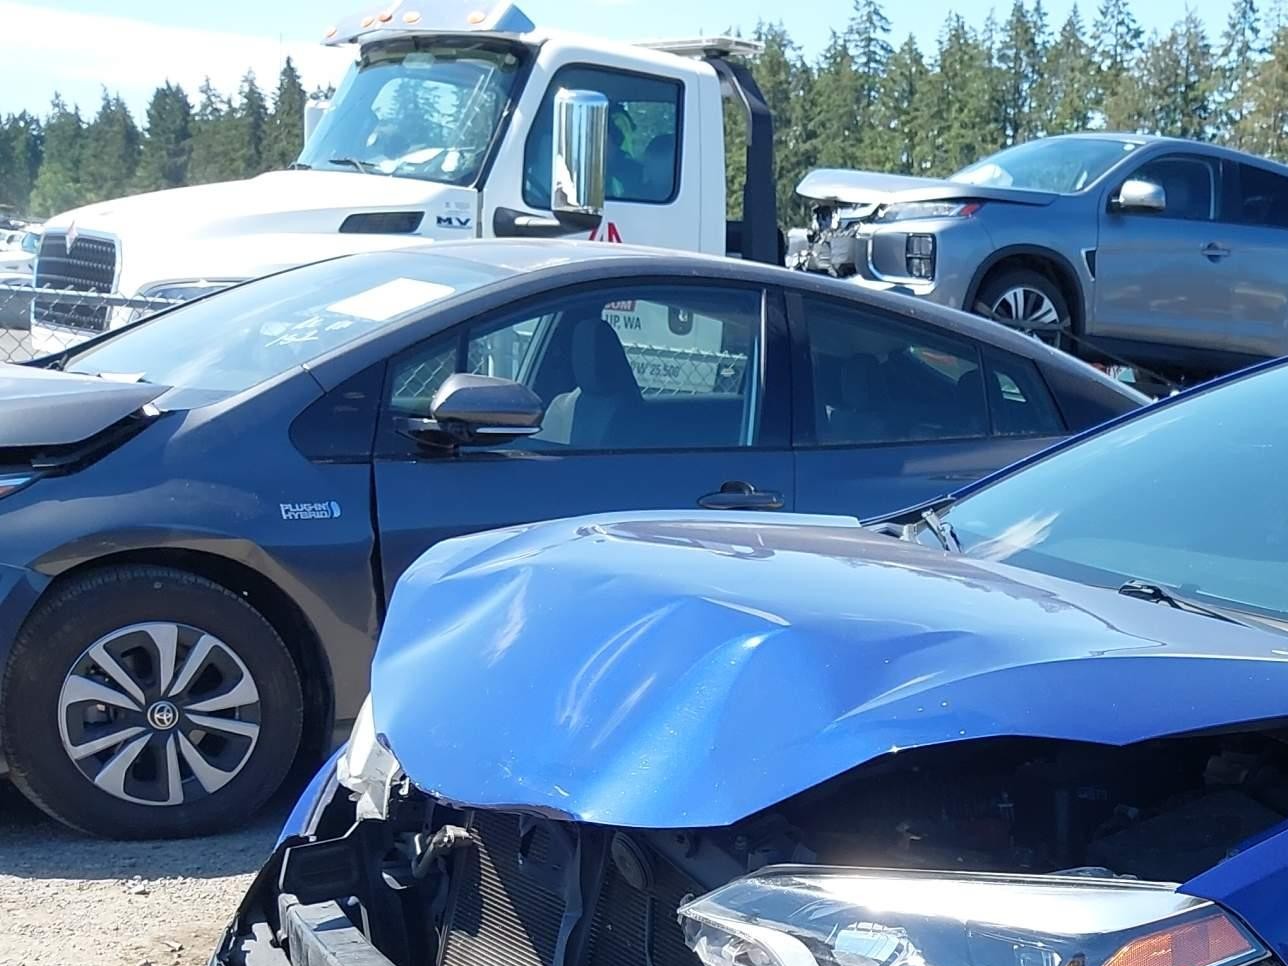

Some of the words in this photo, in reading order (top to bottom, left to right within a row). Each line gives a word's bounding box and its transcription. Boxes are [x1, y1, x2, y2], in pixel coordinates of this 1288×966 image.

[437, 216, 471, 226] MV
[623, 315, 642, 330] WA
[282, 511, 330, 520] HYBRID
